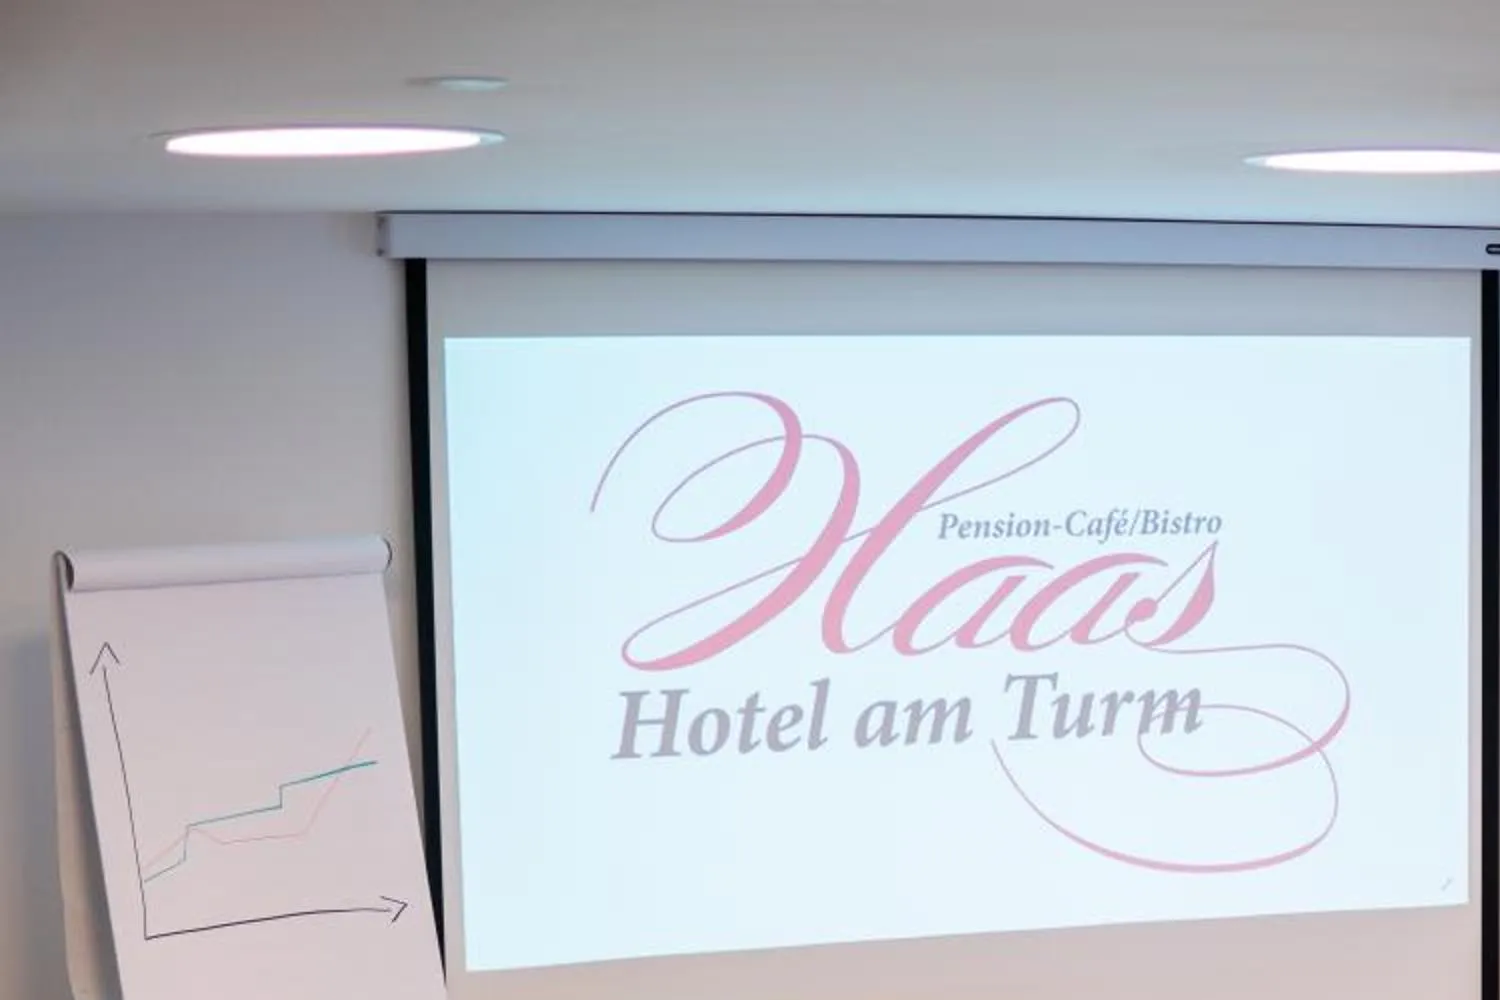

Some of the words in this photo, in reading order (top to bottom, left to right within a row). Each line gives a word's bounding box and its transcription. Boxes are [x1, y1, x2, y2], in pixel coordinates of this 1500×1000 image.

[591, 390, 1218, 671] Haas
[937, 508, 1223, 545] Pension-Café/Bistro
[611, 678, 831, 760] Hotel
[853, 702, 973, 748] am
[1003, 672, 1204, 742] Turm
